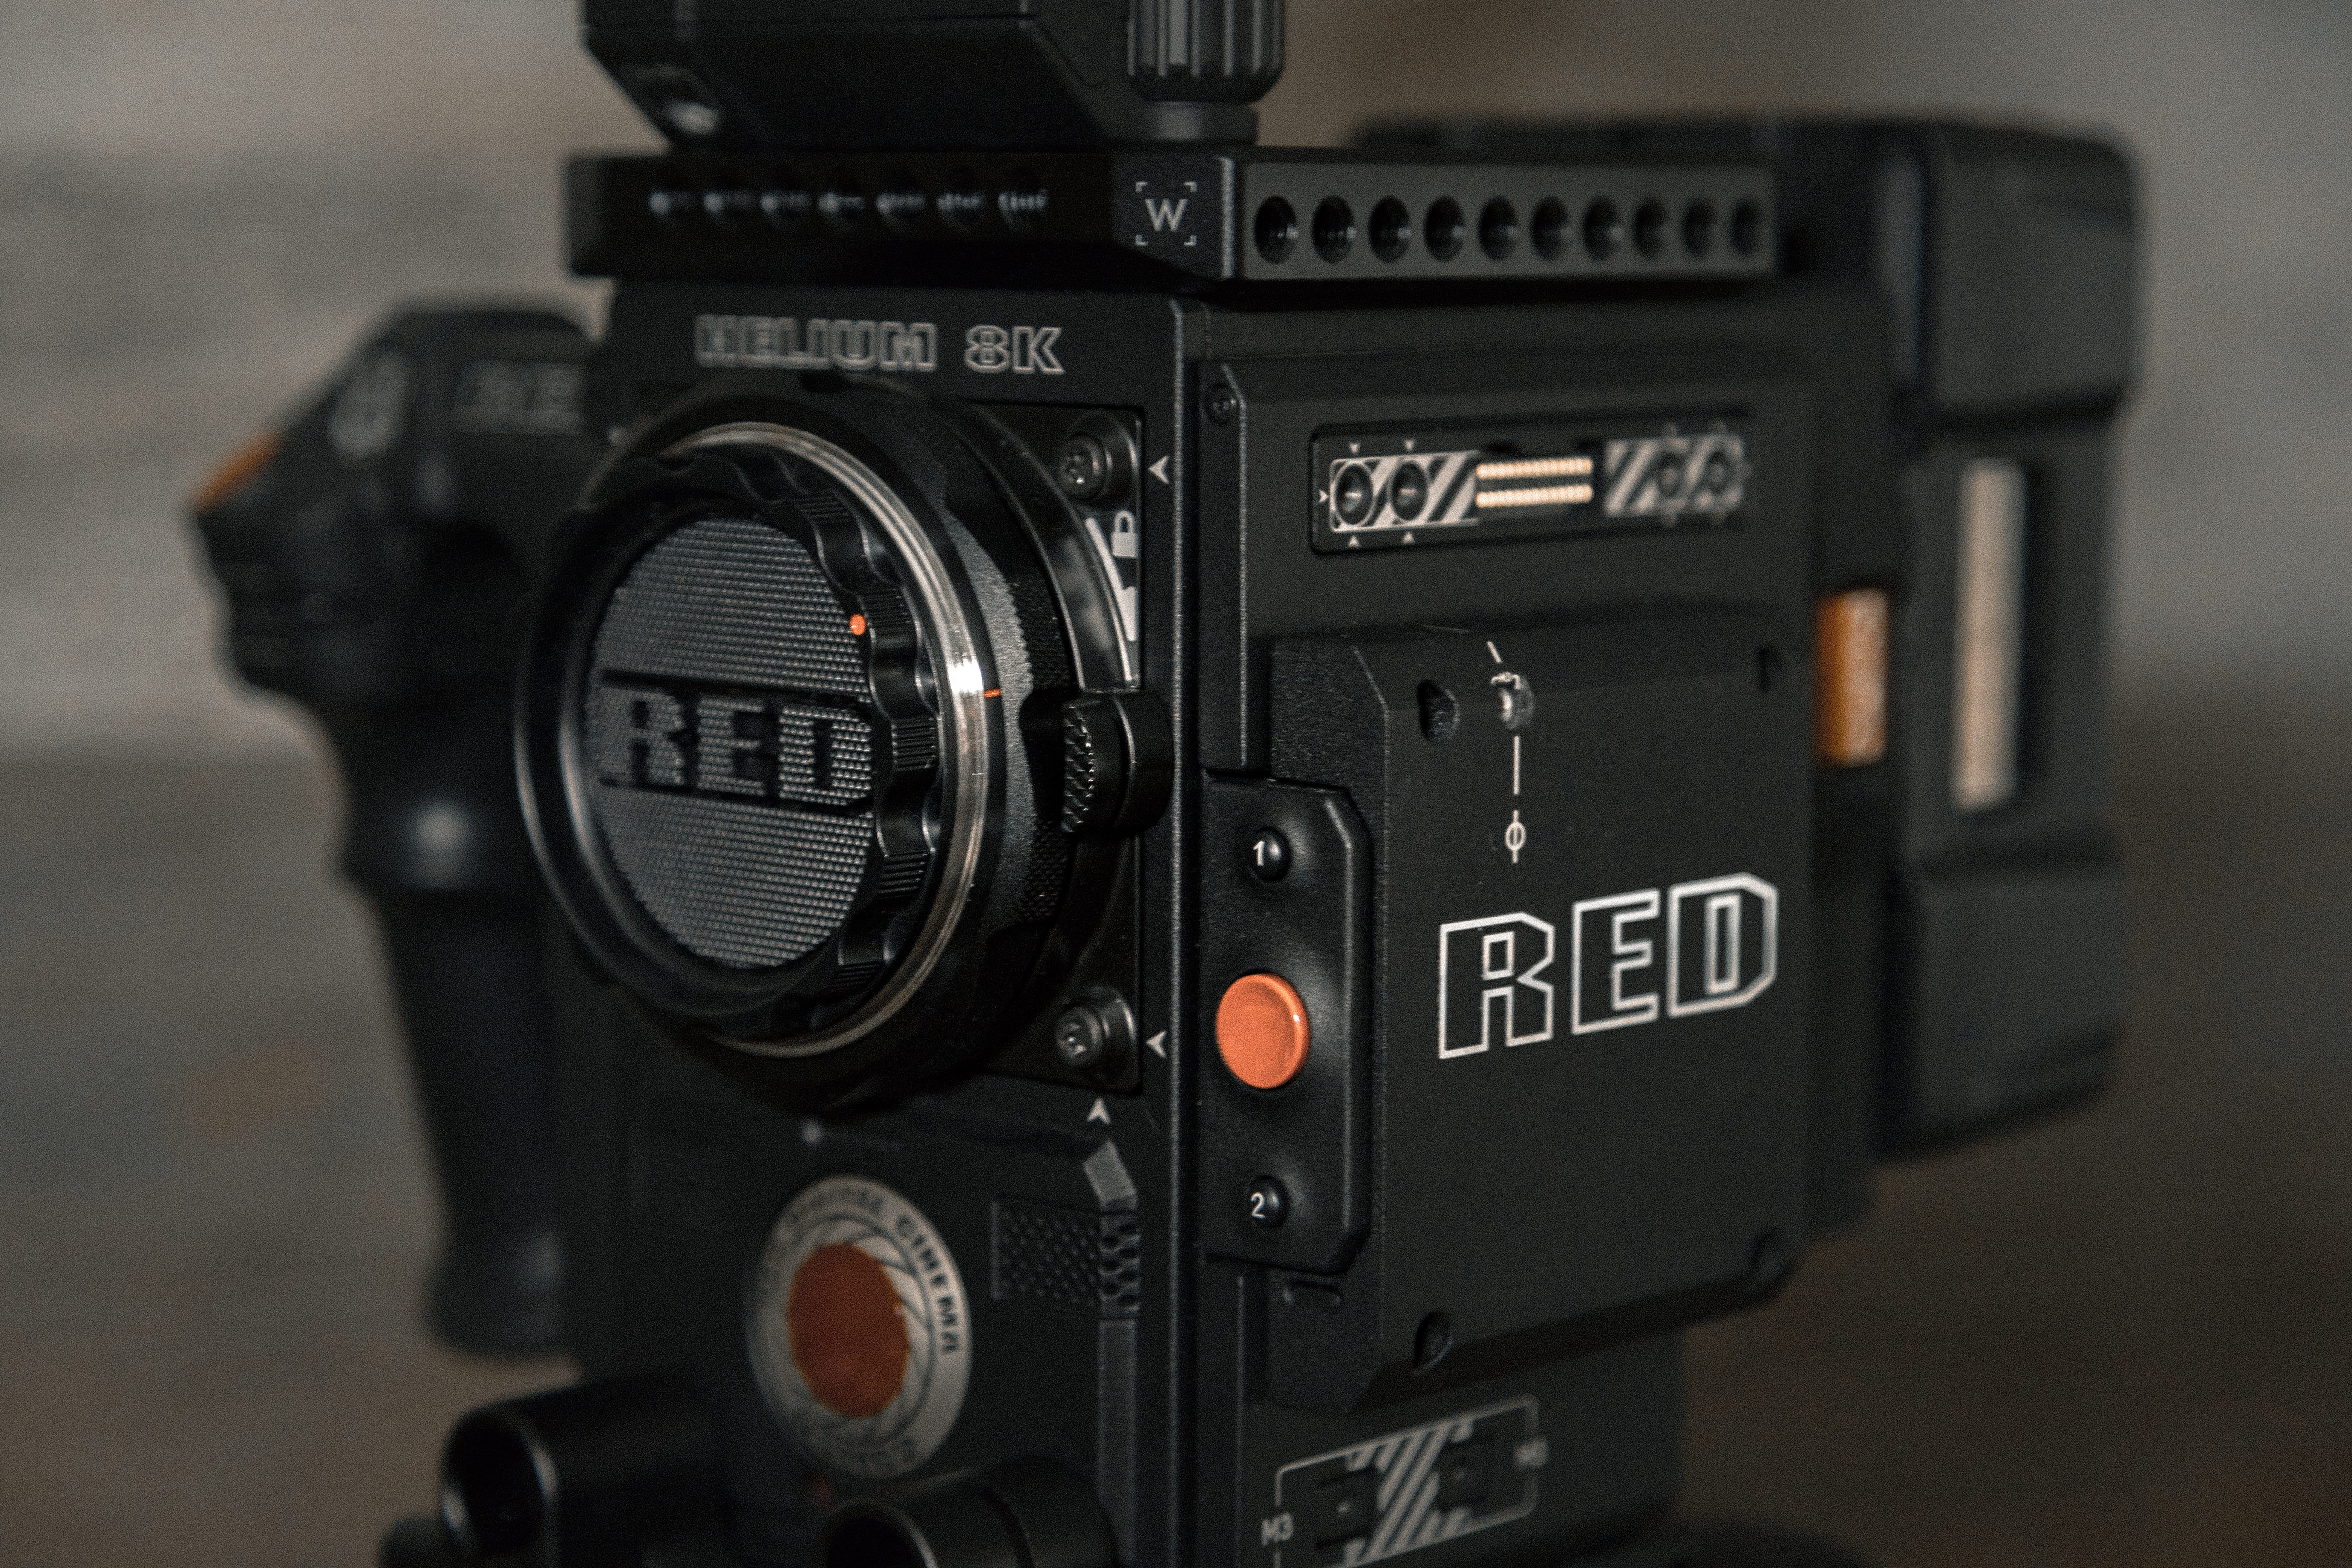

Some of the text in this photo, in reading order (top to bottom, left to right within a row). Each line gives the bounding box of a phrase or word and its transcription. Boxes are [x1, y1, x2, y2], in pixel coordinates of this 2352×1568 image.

[1144, 198, 1188, 232] W
[694, 314, 1066, 375] HELIUM 8K
[602, 686, 873, 807] RED
[1253, 841, 1265, 866] 1
[1438, 872, 1778, 1060] RED
[1250, 1192, 1266, 1220] 2
